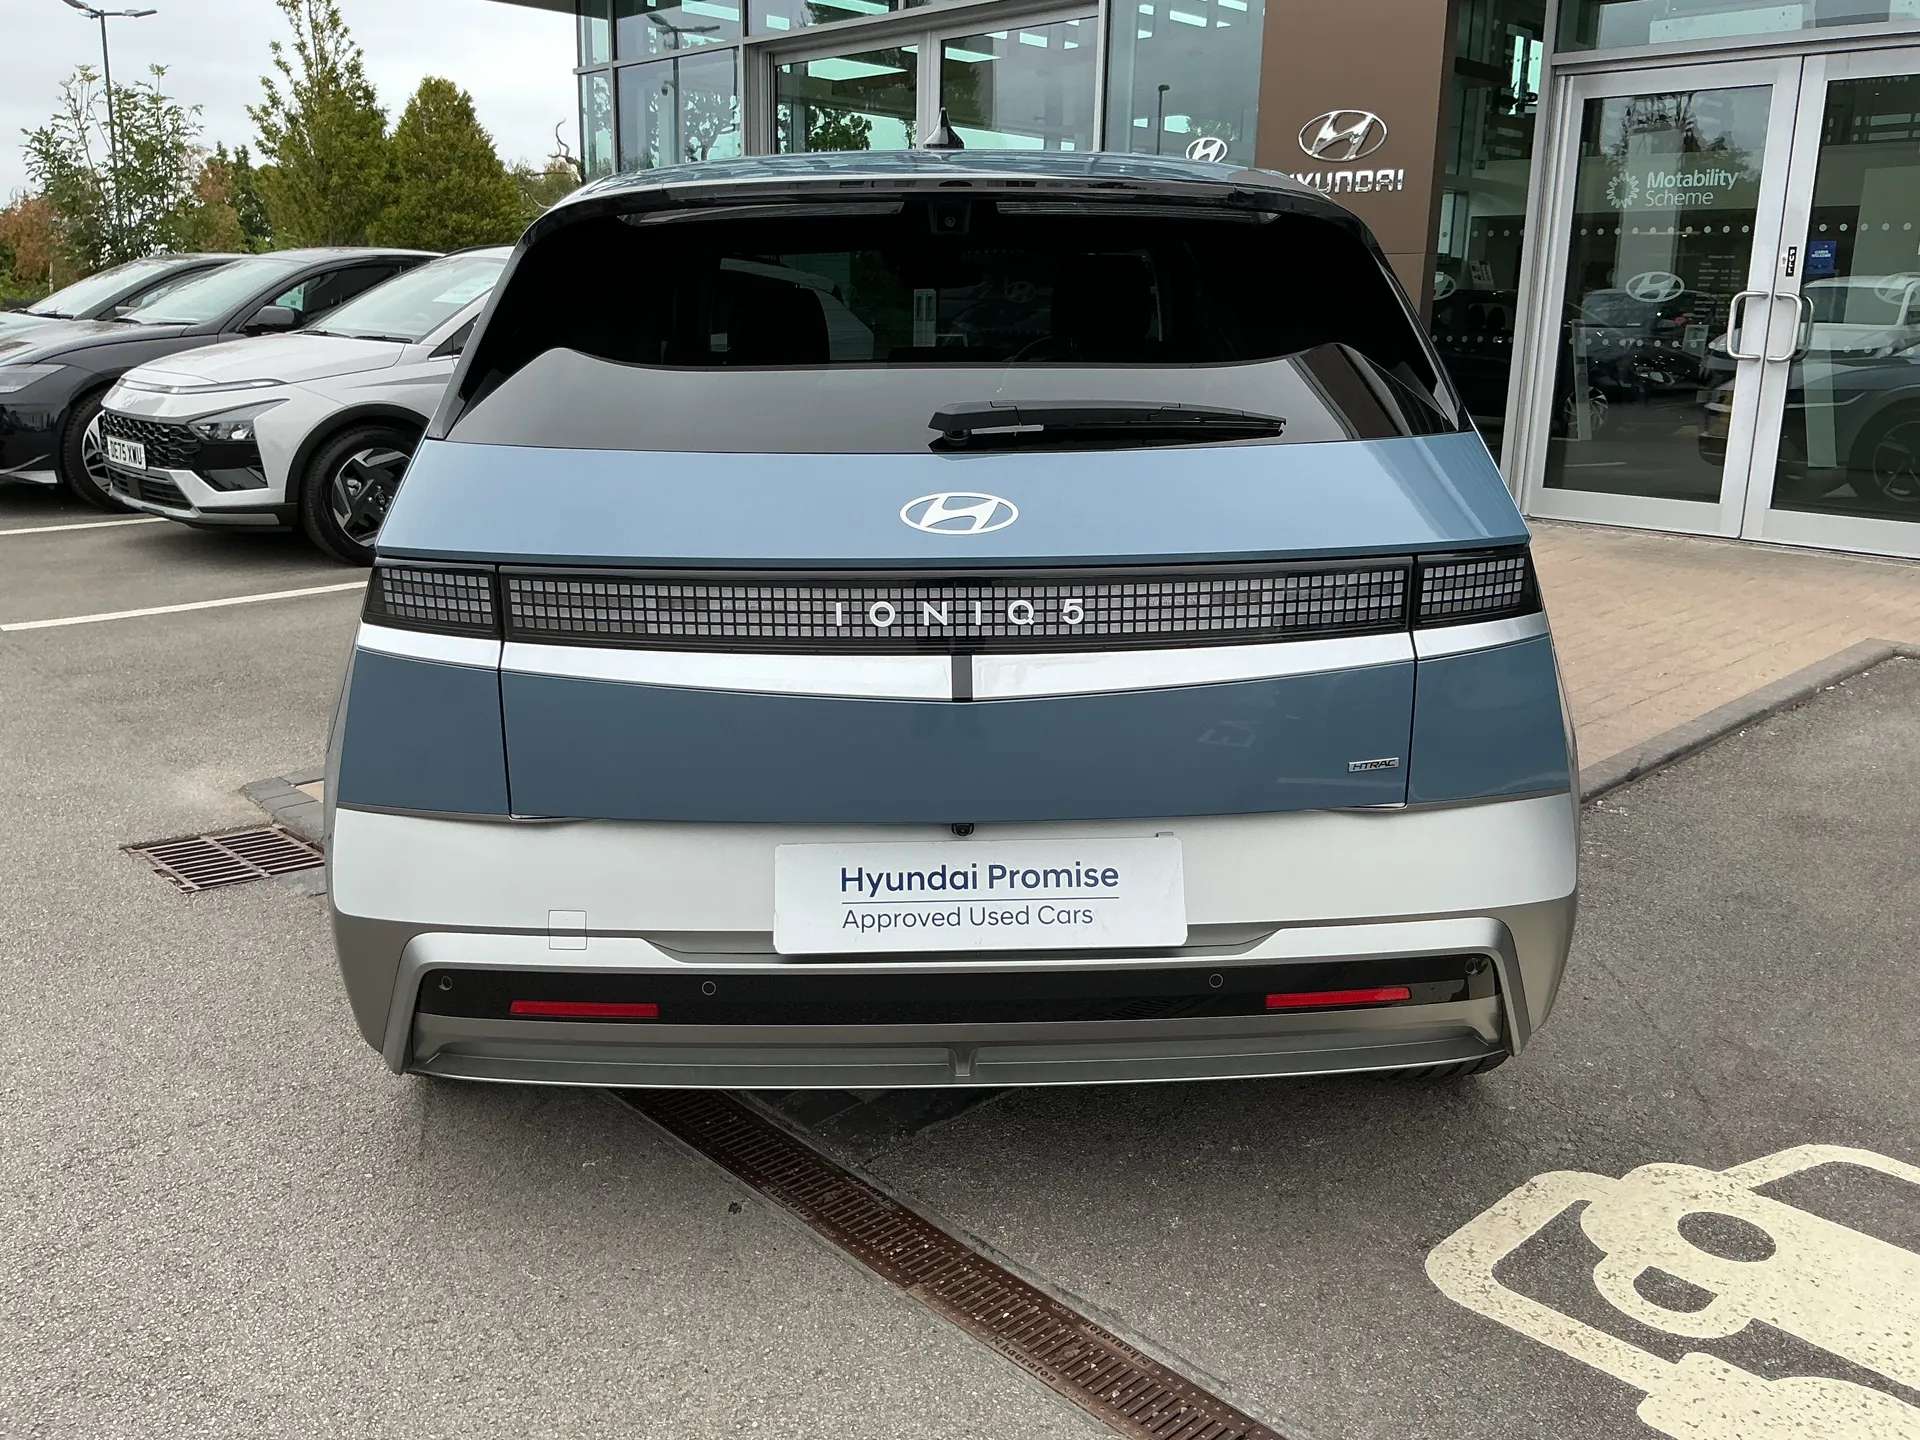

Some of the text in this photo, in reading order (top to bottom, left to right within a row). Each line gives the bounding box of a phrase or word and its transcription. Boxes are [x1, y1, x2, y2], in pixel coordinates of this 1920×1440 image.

[1289, 168, 1404, 194] YUNDAI
[1646, 168, 1740, 190] Motability
[1645, 190, 1714, 207] Scheme
[1787, 248, 1796, 274] PULL
[1352, 759, 1396, 771] HTRAC
[841, 861, 1119, 897] Hyundai Promise
[842, 904, 1094, 933] Approved Used Cars
